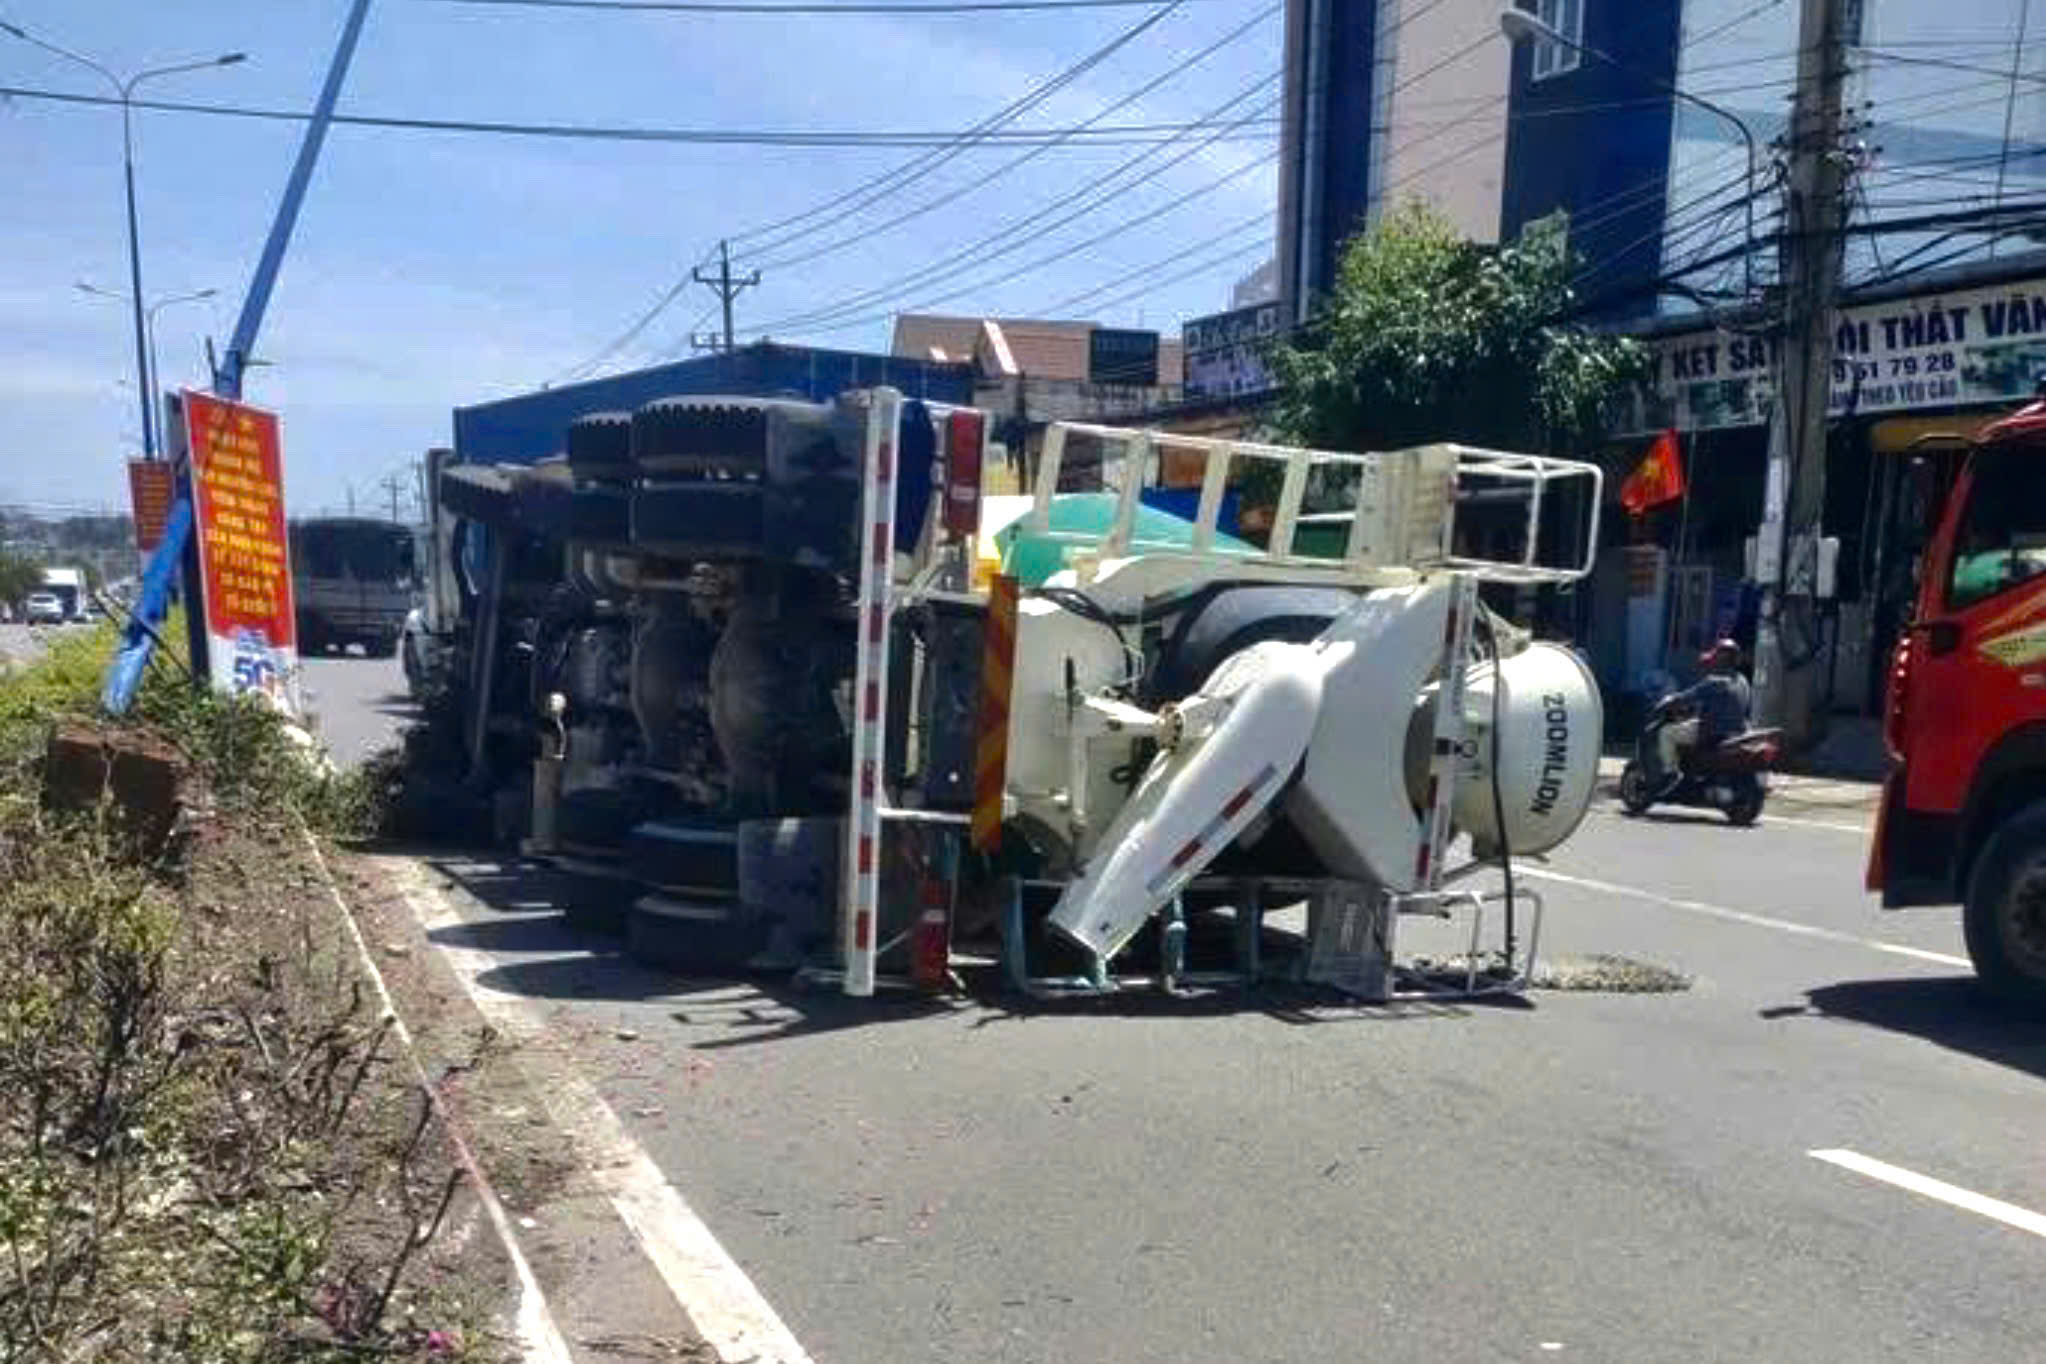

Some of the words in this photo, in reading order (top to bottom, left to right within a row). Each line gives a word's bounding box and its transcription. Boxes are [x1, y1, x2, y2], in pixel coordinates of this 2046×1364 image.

[1887, 355, 1919, 378] 79
[1925, 351, 1957, 374] 28
[1530, 692, 1569, 816] ZOOMLION
